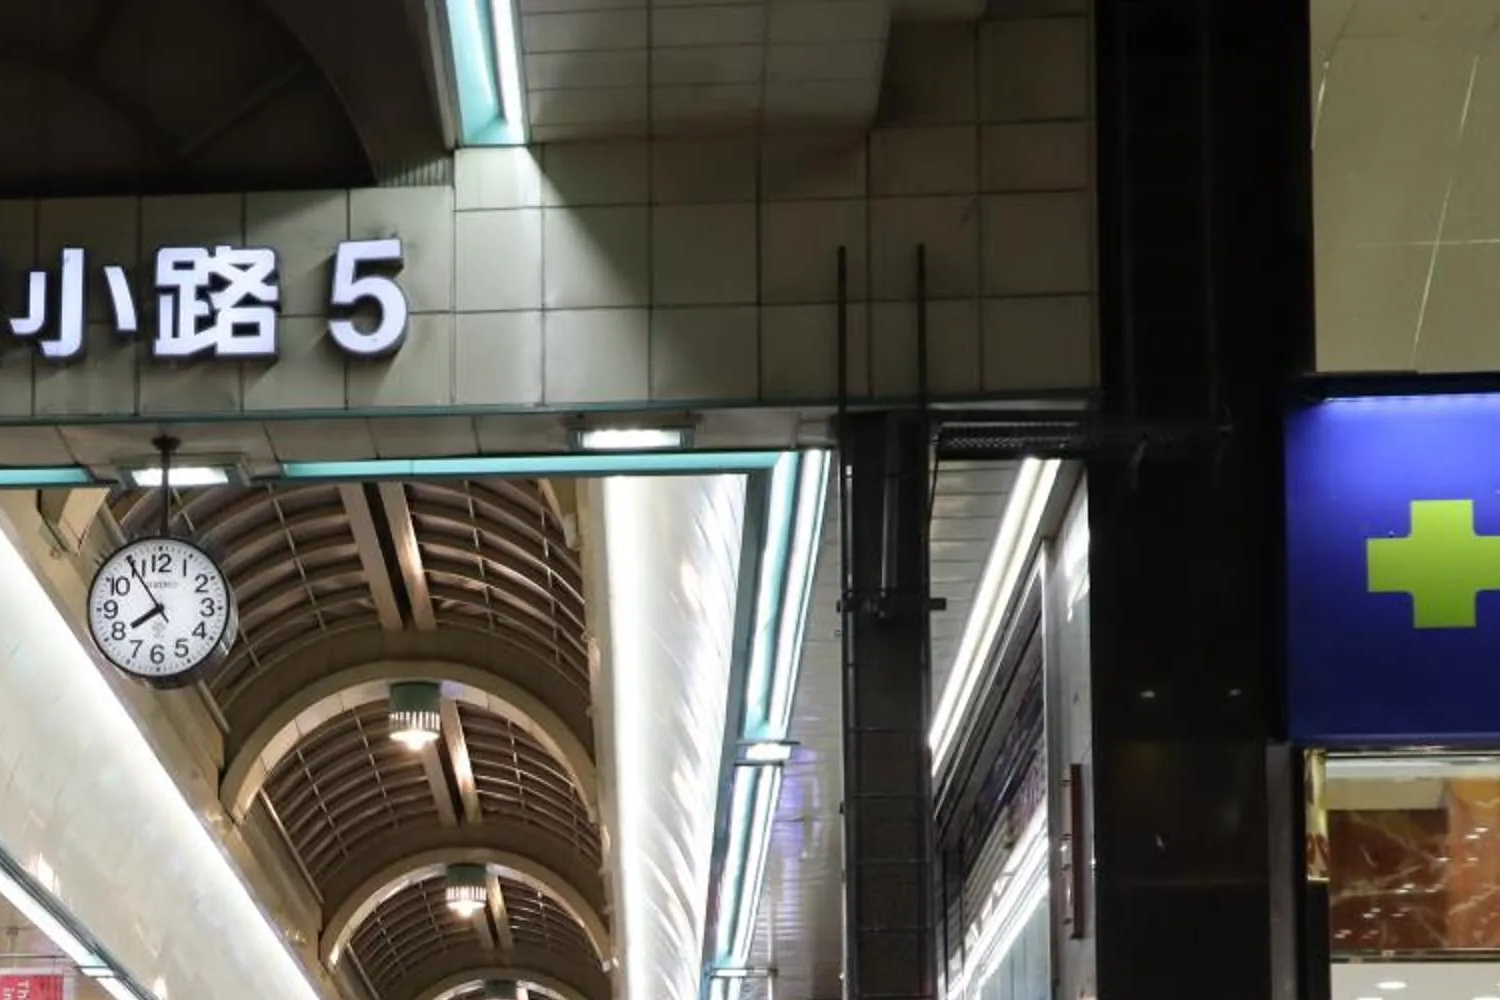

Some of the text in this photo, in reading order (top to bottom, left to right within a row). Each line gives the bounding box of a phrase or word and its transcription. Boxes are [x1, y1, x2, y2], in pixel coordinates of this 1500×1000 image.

[328, 239, 407, 355] 5
[152, 554, 171, 573] 12
[110, 576, 130, 596] 10
[194, 574, 209, 593] 2
[103, 600, 118, 619] 9
[200, 597, 215, 617] 3
[111, 622, 126, 641] 8
[192, 622, 206, 639] 4
[130, 640, 143, 658] 7
[150, 644, 165, 664] 6
[174, 639, 189, 657] 5
